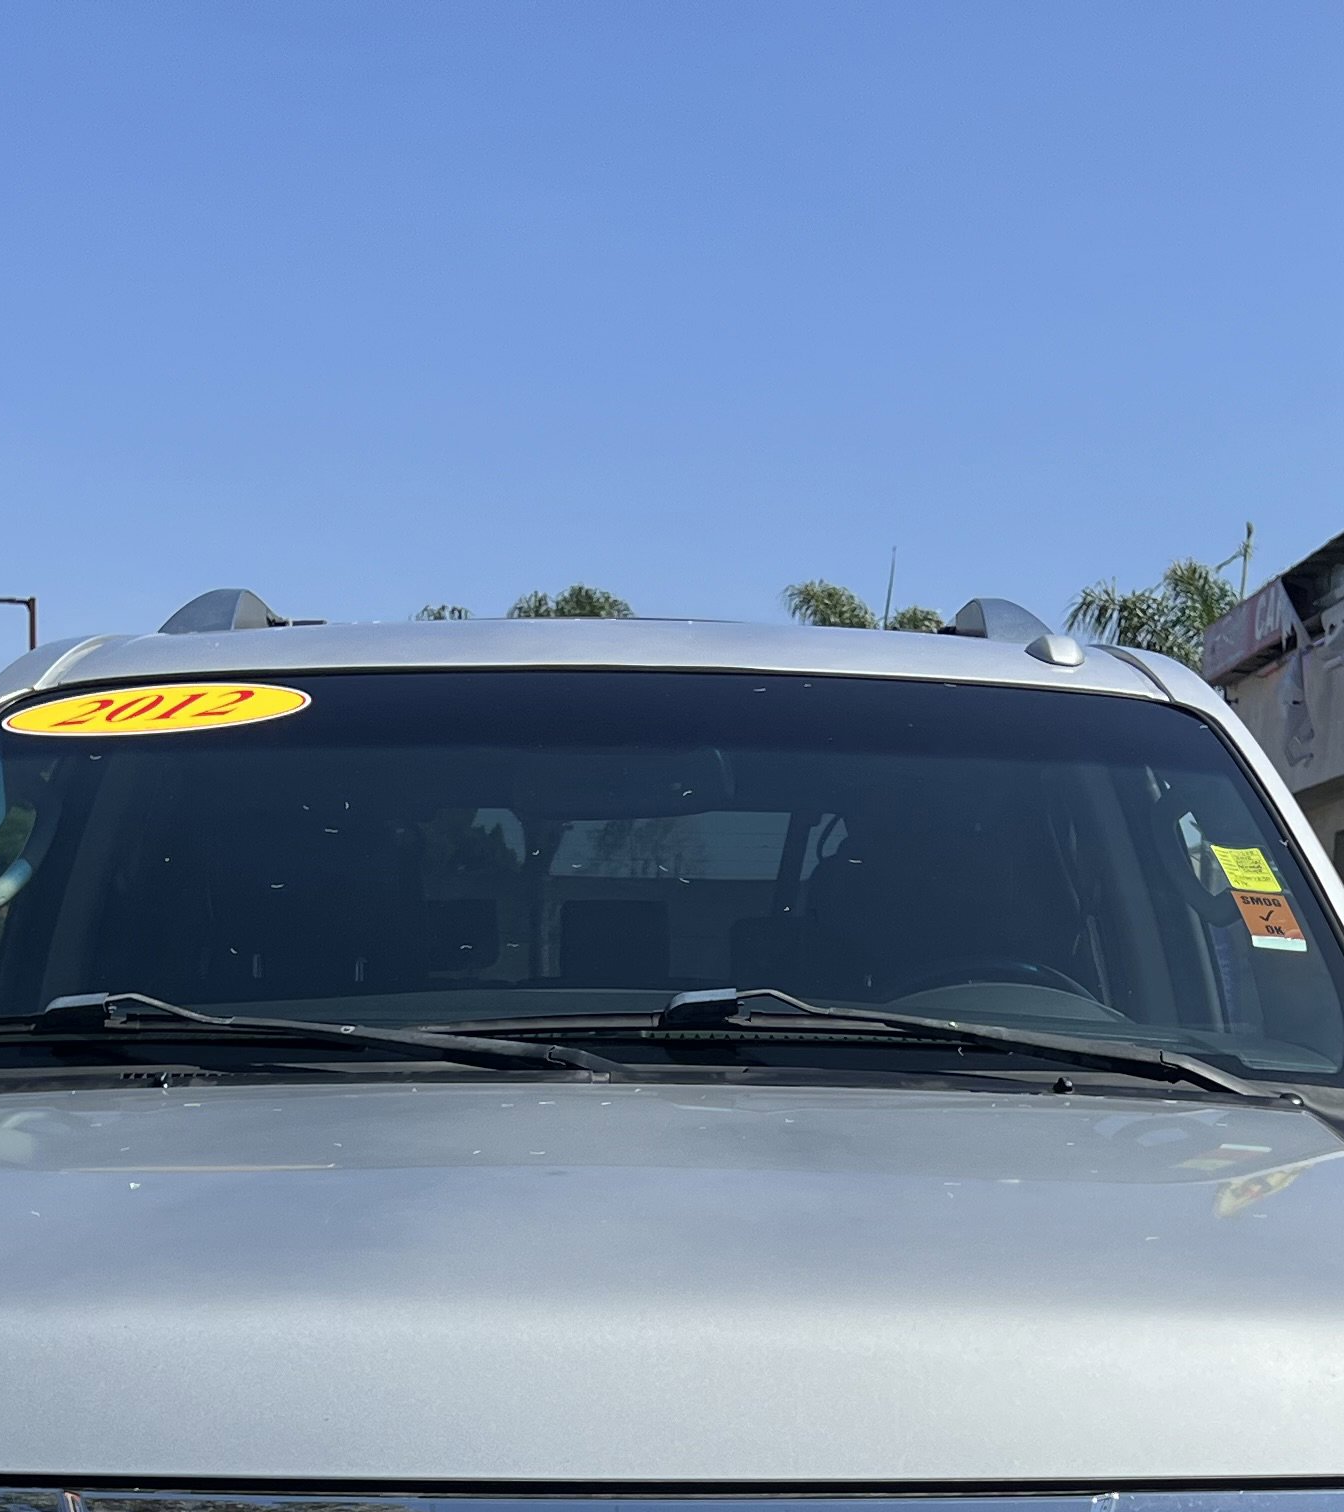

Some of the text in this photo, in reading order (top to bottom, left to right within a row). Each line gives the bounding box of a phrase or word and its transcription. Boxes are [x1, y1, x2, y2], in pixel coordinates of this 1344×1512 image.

[48, 689, 255, 728] 2012
[1240, 895, 1282, 907] SMOG
[1265, 924, 1286, 936] OK
